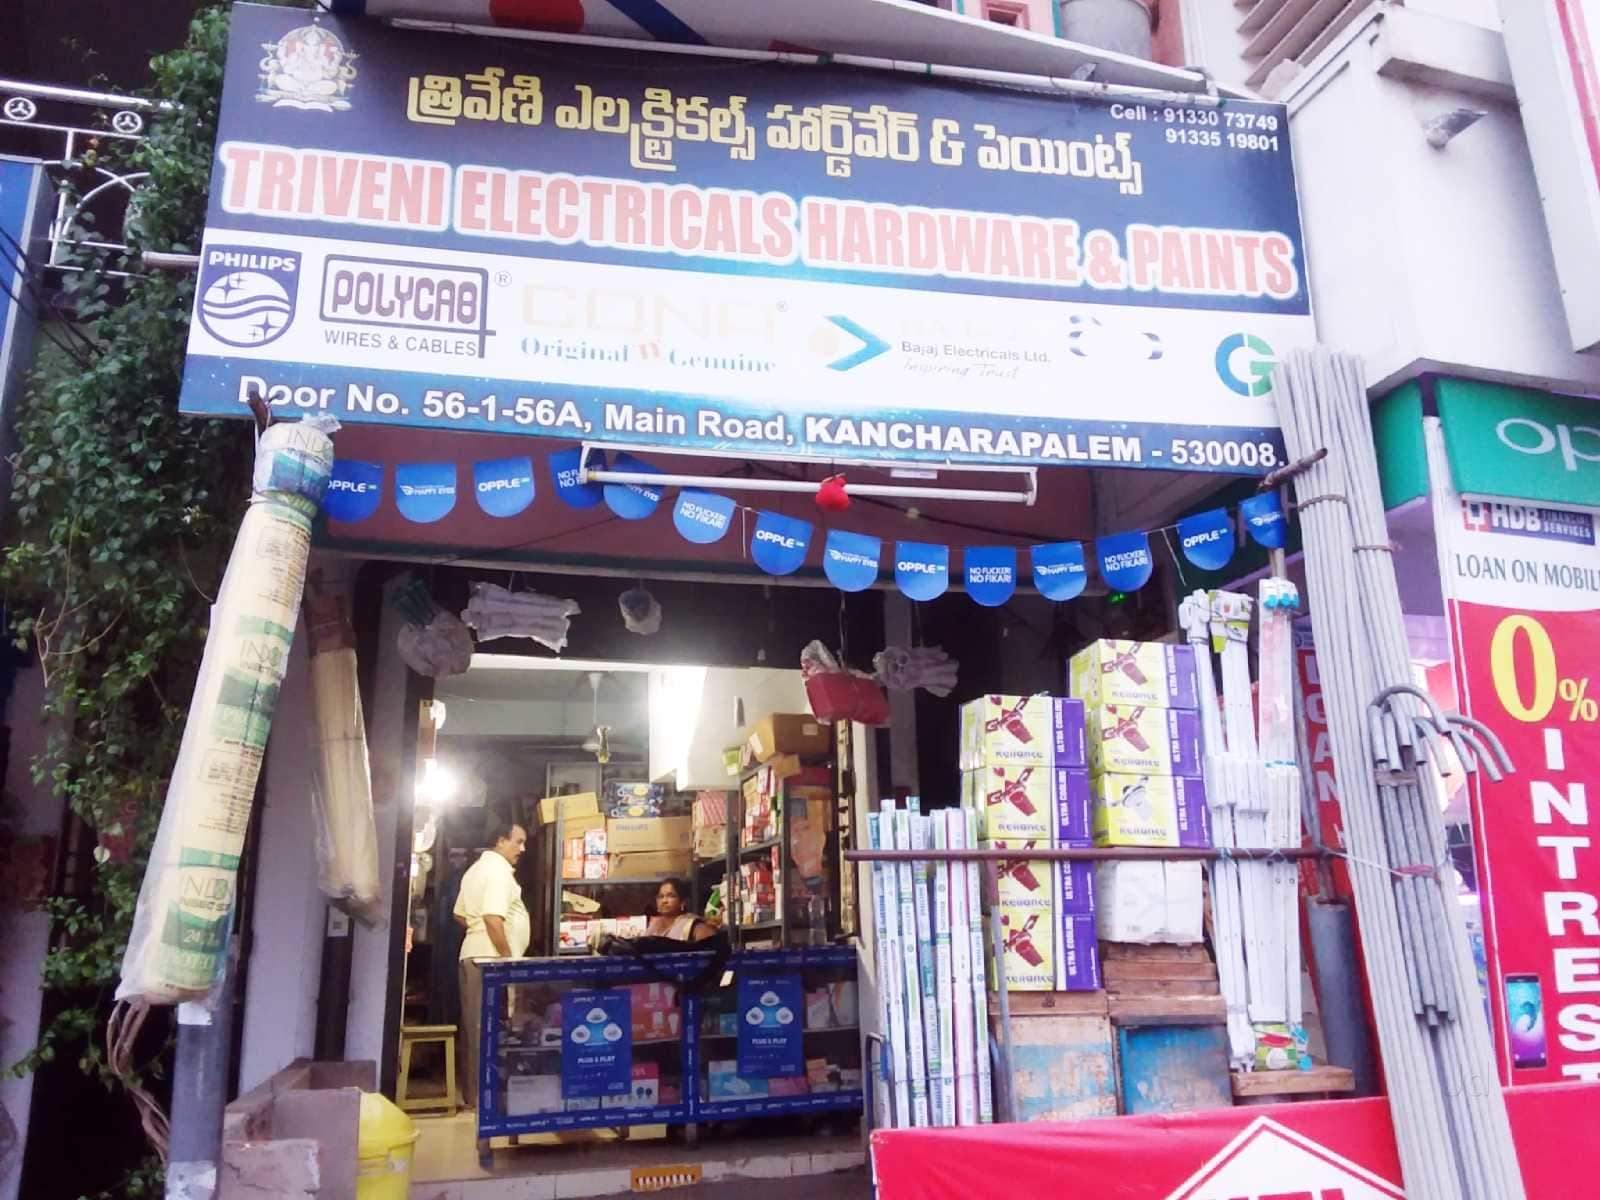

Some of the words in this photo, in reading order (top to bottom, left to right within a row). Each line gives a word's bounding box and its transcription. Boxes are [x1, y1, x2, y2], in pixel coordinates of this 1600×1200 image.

[406, 65, 543, 127] త్రివేణి
[929, 117, 966, 168] &
[1110, 104, 1147, 121] Cell
[1163, 107, 1219, 126] 91330
[1223, 112, 1278, 131] 73749
[1165, 128, 1221, 147] 91335
[1226, 132, 1279, 151] 19801
[222, 144, 449, 229] TRIVENI
[456, 168, 797, 262] ELECTRICALS
[805, 202, 1079, 284] HARDWARE
[1085, 233, 1122, 287] &
[1129, 227, 1295, 296] PAINTS
[209, 250, 296, 272] PHILIPS
[331, 269, 478, 325] POLYCAB
[324, 330, 384, 350] WIRES
[388, 334, 399, 350] &
[405, 335, 477, 356] CABLES
[900, 340, 938, 358] Bajaj
[943, 343, 1021, 362] Electricals
[1023, 349, 1052, 364] Ltd.
[239, 375, 336, 409] Door
[347, 384, 408, 416] No.
[423, 390, 592, 433] 56-1-56A,
[605, 405, 686, 435] Main
[697, 409, 793, 445] Road,
[805, 417, 1142, 464] KANCHARAPALEM
[1171, 439, 1285, 467] 530008.
[478, 478, 521, 492] OPPLE
[1491, 502, 1541, 532] HDB
[1543, 521, 1592, 538] SERVICES
[756, 530, 796, 549] OPPLE
[1183, 530, 1220, 548] OPPLE
[897, 561, 936, 574] OPPLE
[1456, 553, 1506, 581] LOAN
[1511, 559, 1538, 585] ON
[1544, 563, 1600, 592] MOBIL
[1490, 614, 1599, 722] 0%
